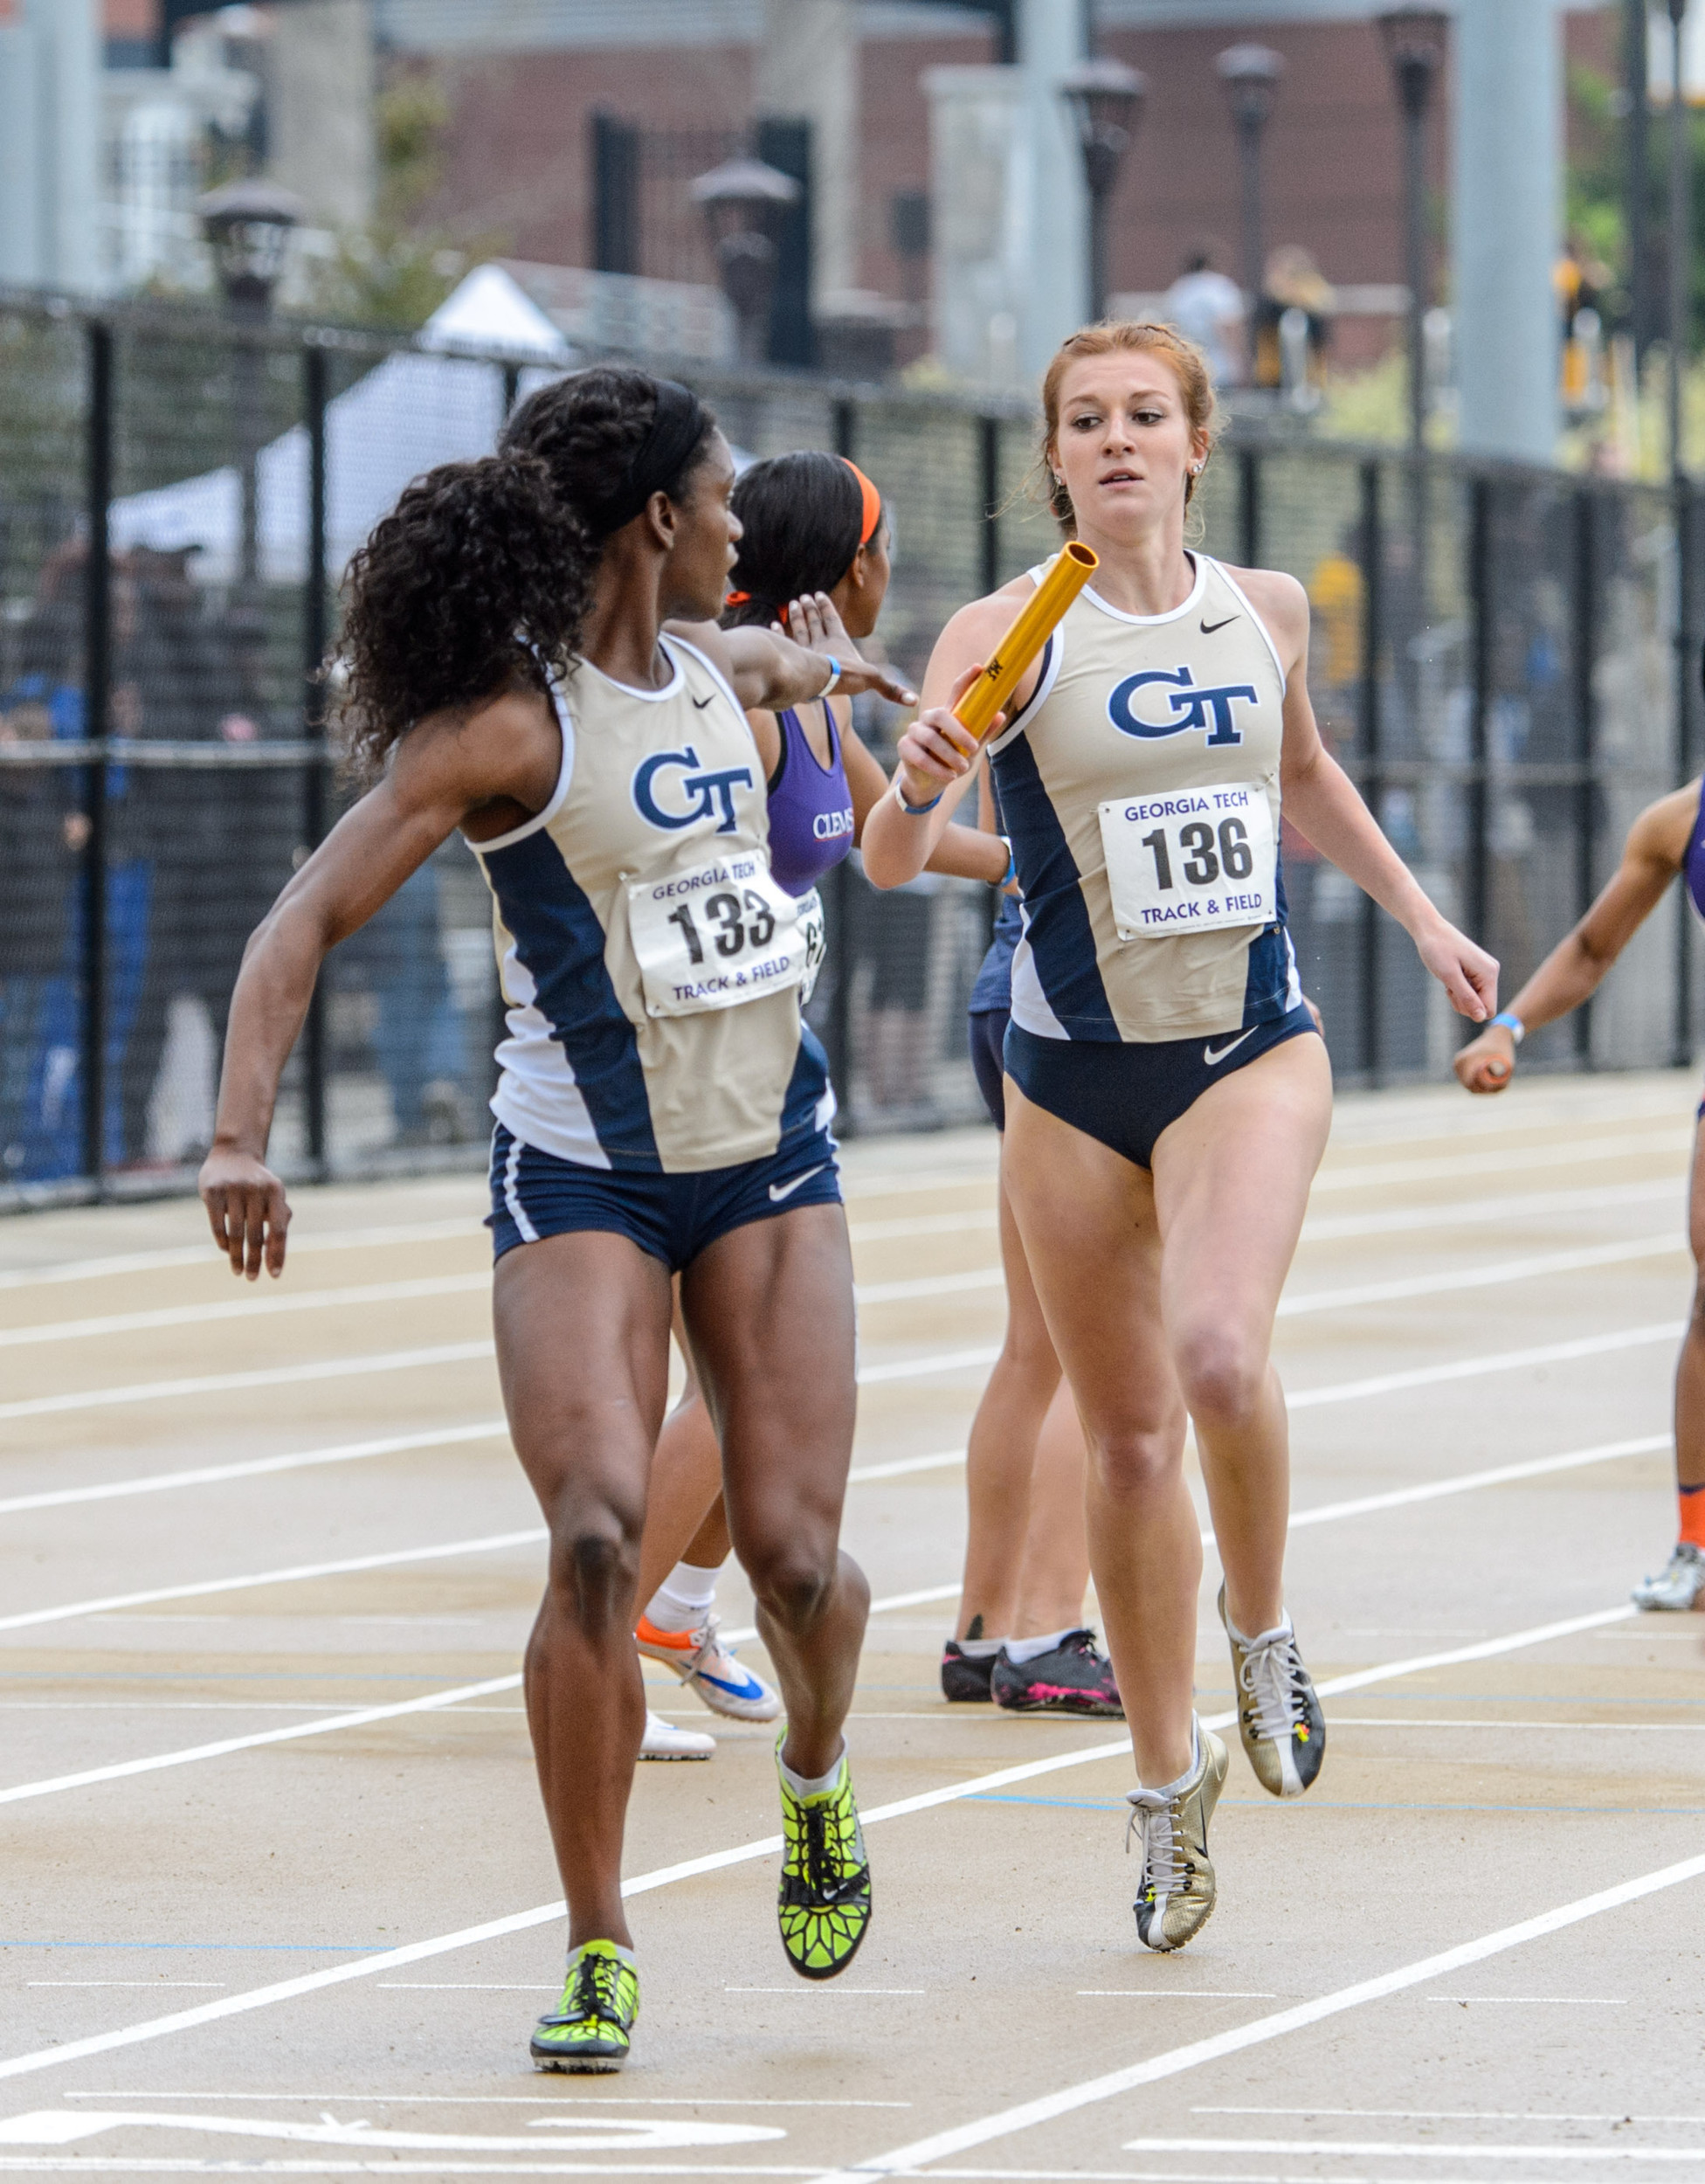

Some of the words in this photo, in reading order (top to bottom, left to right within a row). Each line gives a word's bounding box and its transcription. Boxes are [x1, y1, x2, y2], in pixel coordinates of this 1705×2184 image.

[1108, 664, 1260, 747] GT
[631, 746, 754, 835] GT
[1124, 797, 1210, 821] GEORGIA
[1213, 791, 1249, 809] TECH
[652, 867, 730, 900] GEORGIA
[731, 861, 756, 880] TECH
[1142, 817, 1253, 891] 136
[668, 888, 776, 965] 133
[1141, 901, 1201, 924] TRACK
[1207, 898, 1219, 914] &
[1225, 893, 1262, 911] FIELD
[673, 976, 728, 1000] TRACK
[735, 971, 747, 986] &
[751, 956, 790, 982] FIELD
